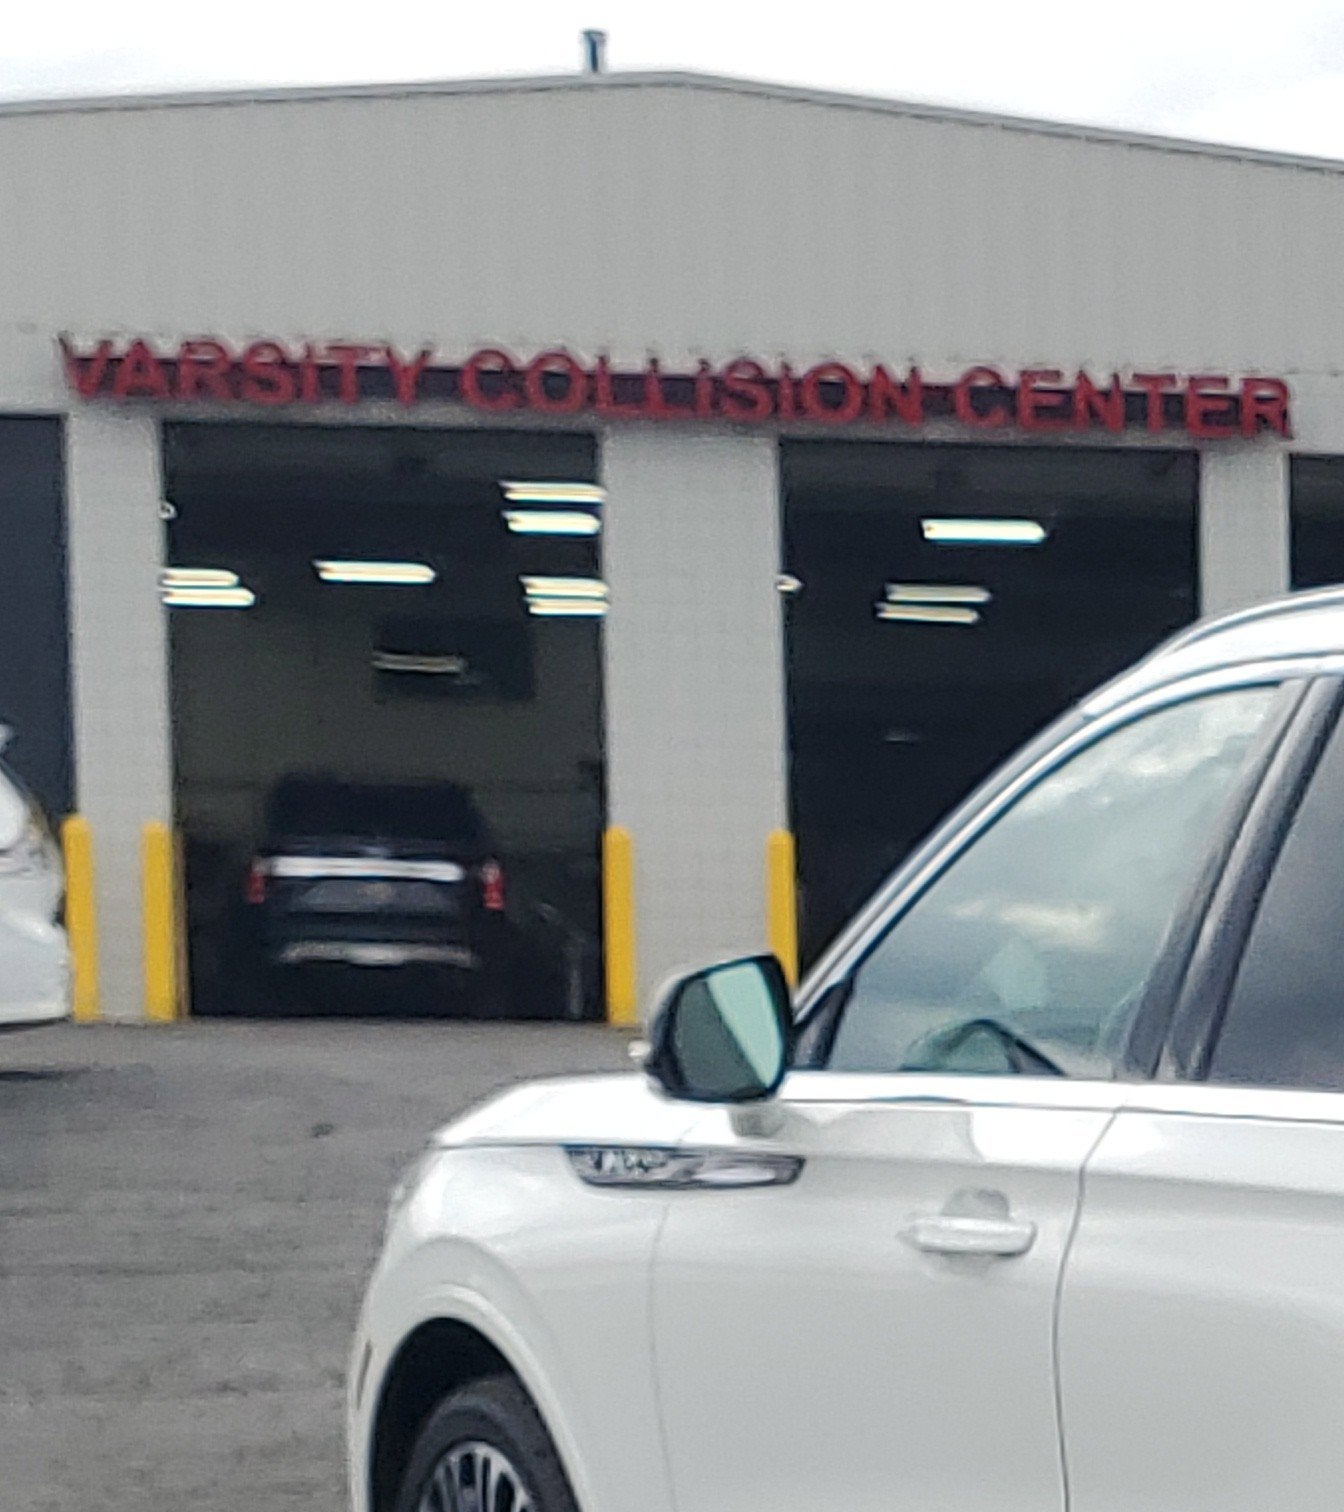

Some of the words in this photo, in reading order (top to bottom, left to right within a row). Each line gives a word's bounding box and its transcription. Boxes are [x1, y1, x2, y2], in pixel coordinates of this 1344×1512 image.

[59, 334, 436, 408] VARSITY
[457, 348, 923, 427] COLLISION
[952, 365, 1294, 439] CENTER
